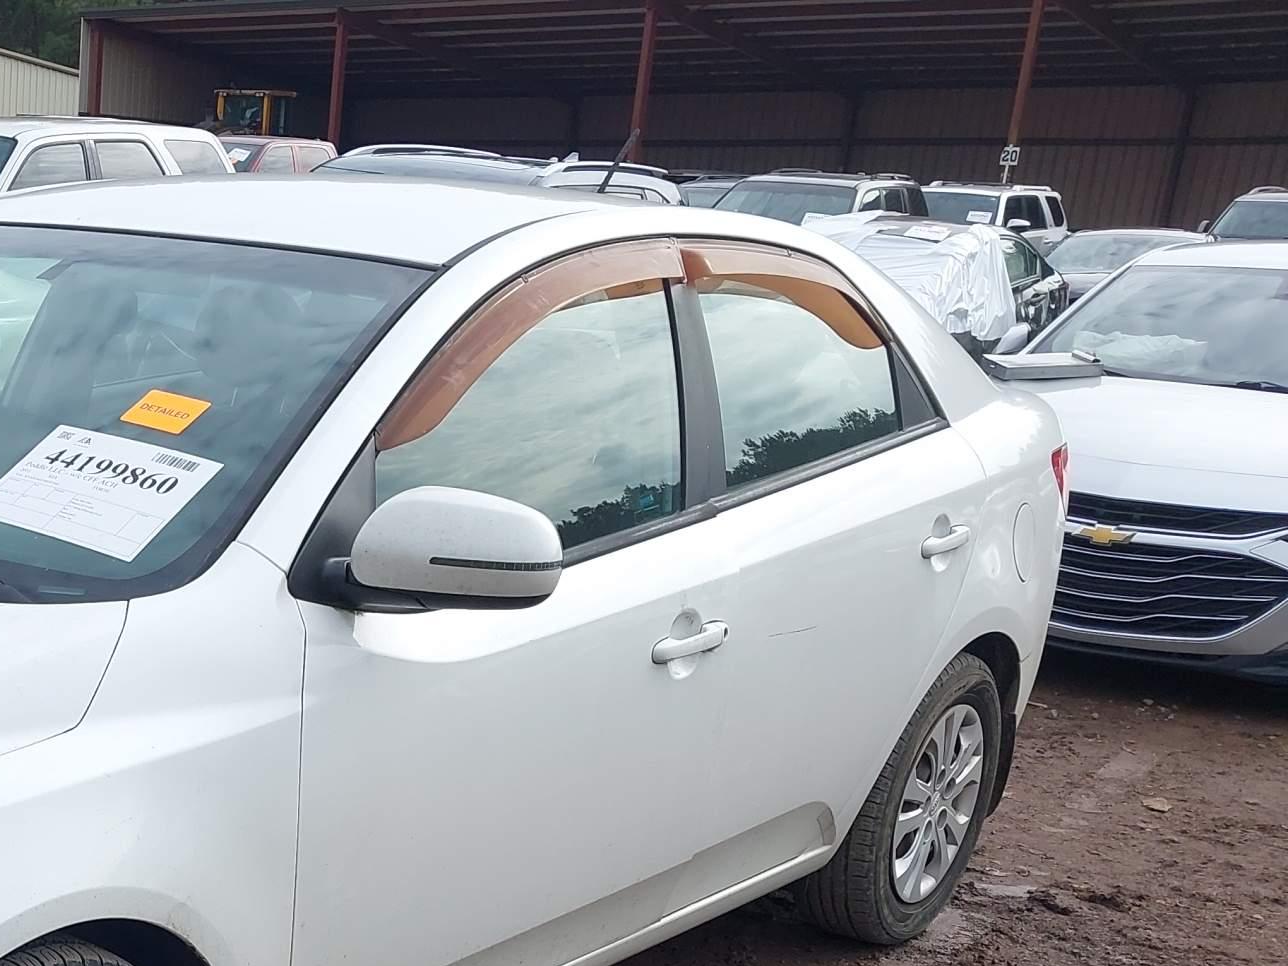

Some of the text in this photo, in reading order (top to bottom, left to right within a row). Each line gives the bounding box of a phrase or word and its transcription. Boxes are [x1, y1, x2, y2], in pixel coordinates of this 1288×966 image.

[1002, 150, 1017, 162] 20
[140, 402, 190, 420] DETAILED
[44, 449, 179, 494] 44199860
